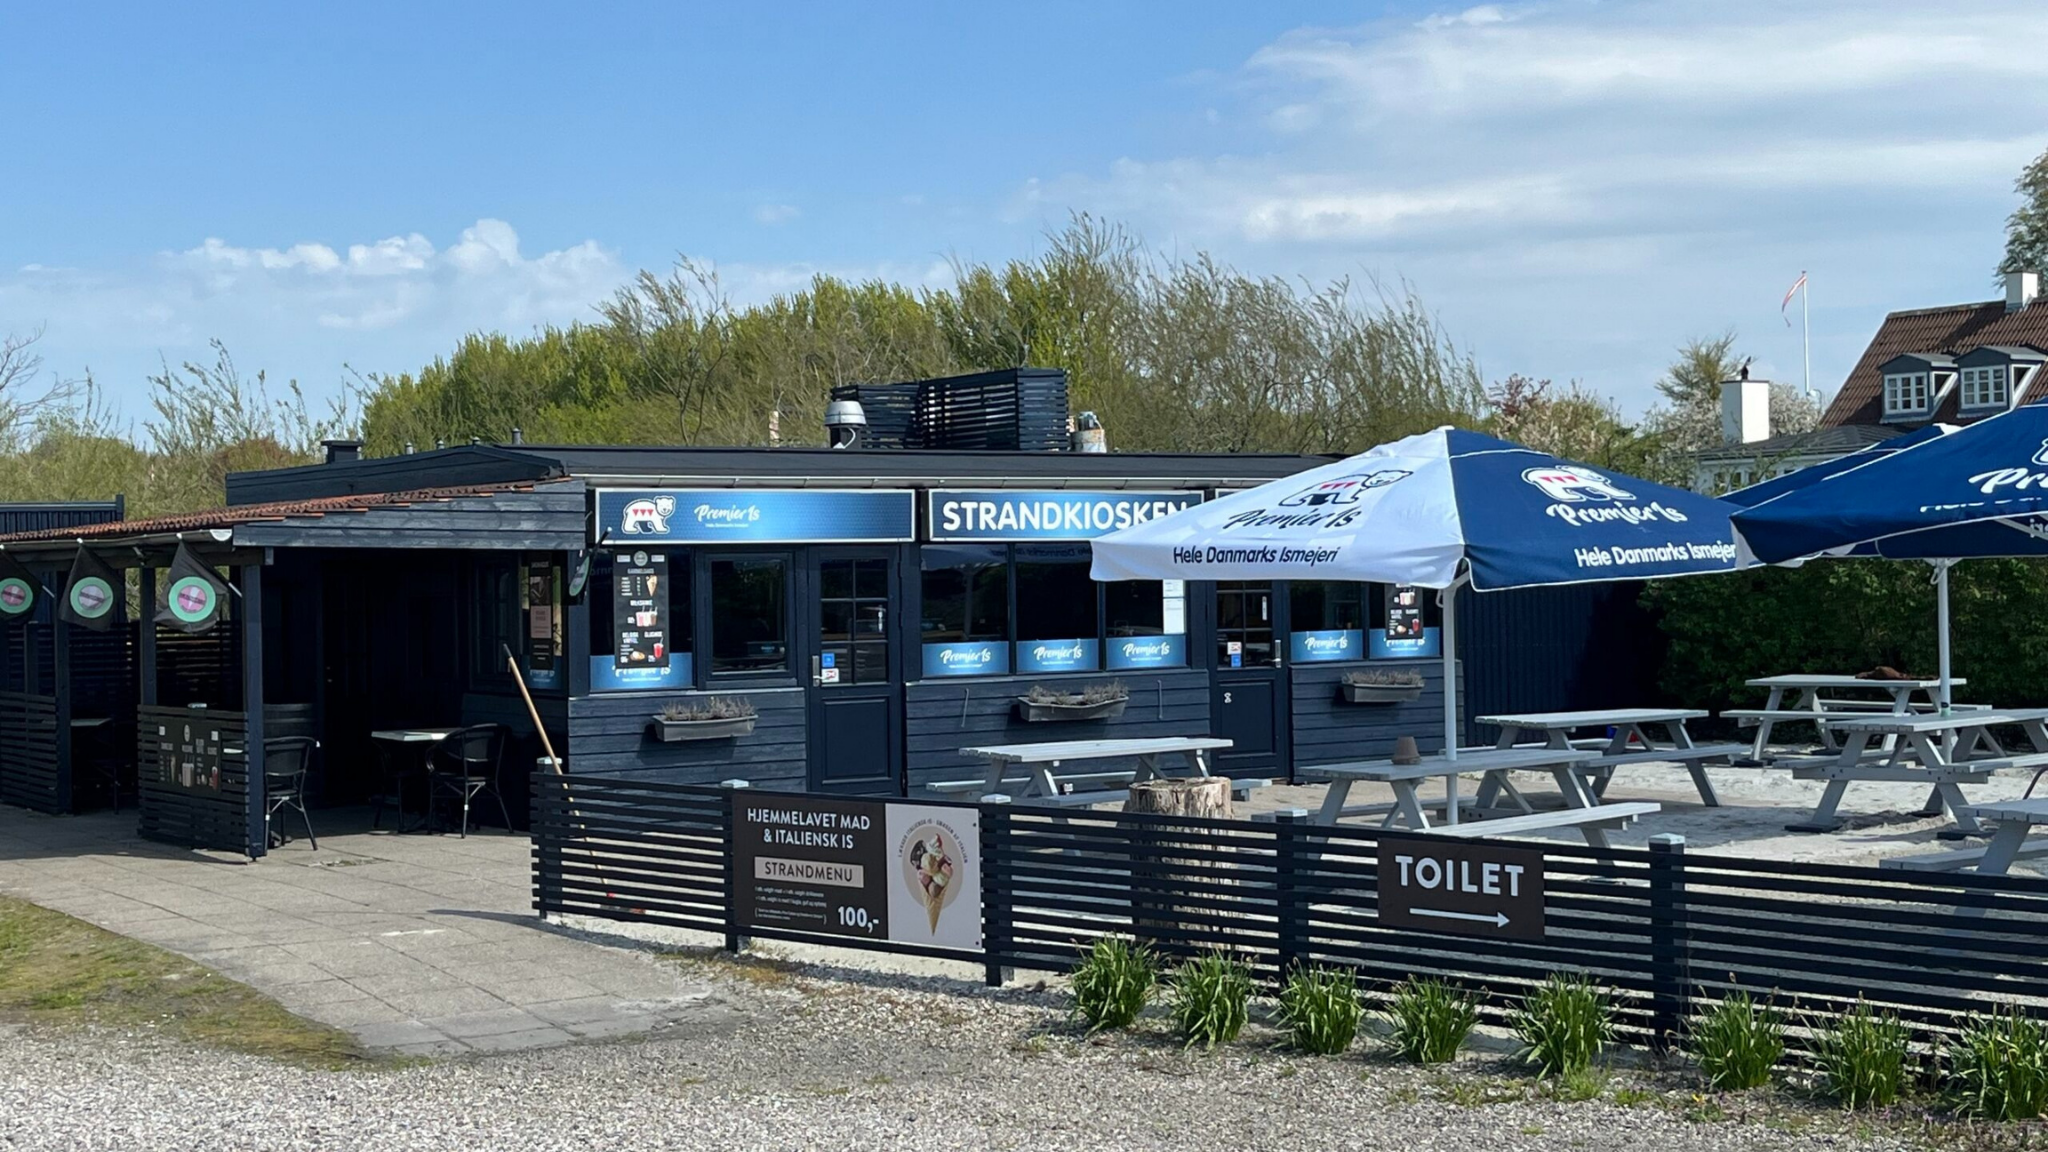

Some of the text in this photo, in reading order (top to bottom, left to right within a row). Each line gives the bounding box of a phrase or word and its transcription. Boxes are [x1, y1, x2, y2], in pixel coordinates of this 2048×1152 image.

[694, 504, 745, 522] Premier
[1222, 508, 1335, 529] Premier
[1546, 501, 1658, 526] Premier
[1173, 545, 1341, 567] Hele Danmarks Ismejeri
[1574, 540, 1736, 568] Hele Danmarks Ismejer
[1033, 646, 1072, 661] Premier
[1122, 643, 1159, 658] Premier
[1304, 636, 1340, 650] Premier
[940, 649, 981, 664] Premier
[747, 808, 871, 830] HJEMMELAVET MAD
[763, 828, 854, 849] & ITALIENSK IS
[764, 861, 853, 882] STRANDMENU
[1395, 855, 1524, 897] TOILET
[838, 906, 879, 933] 100,-
